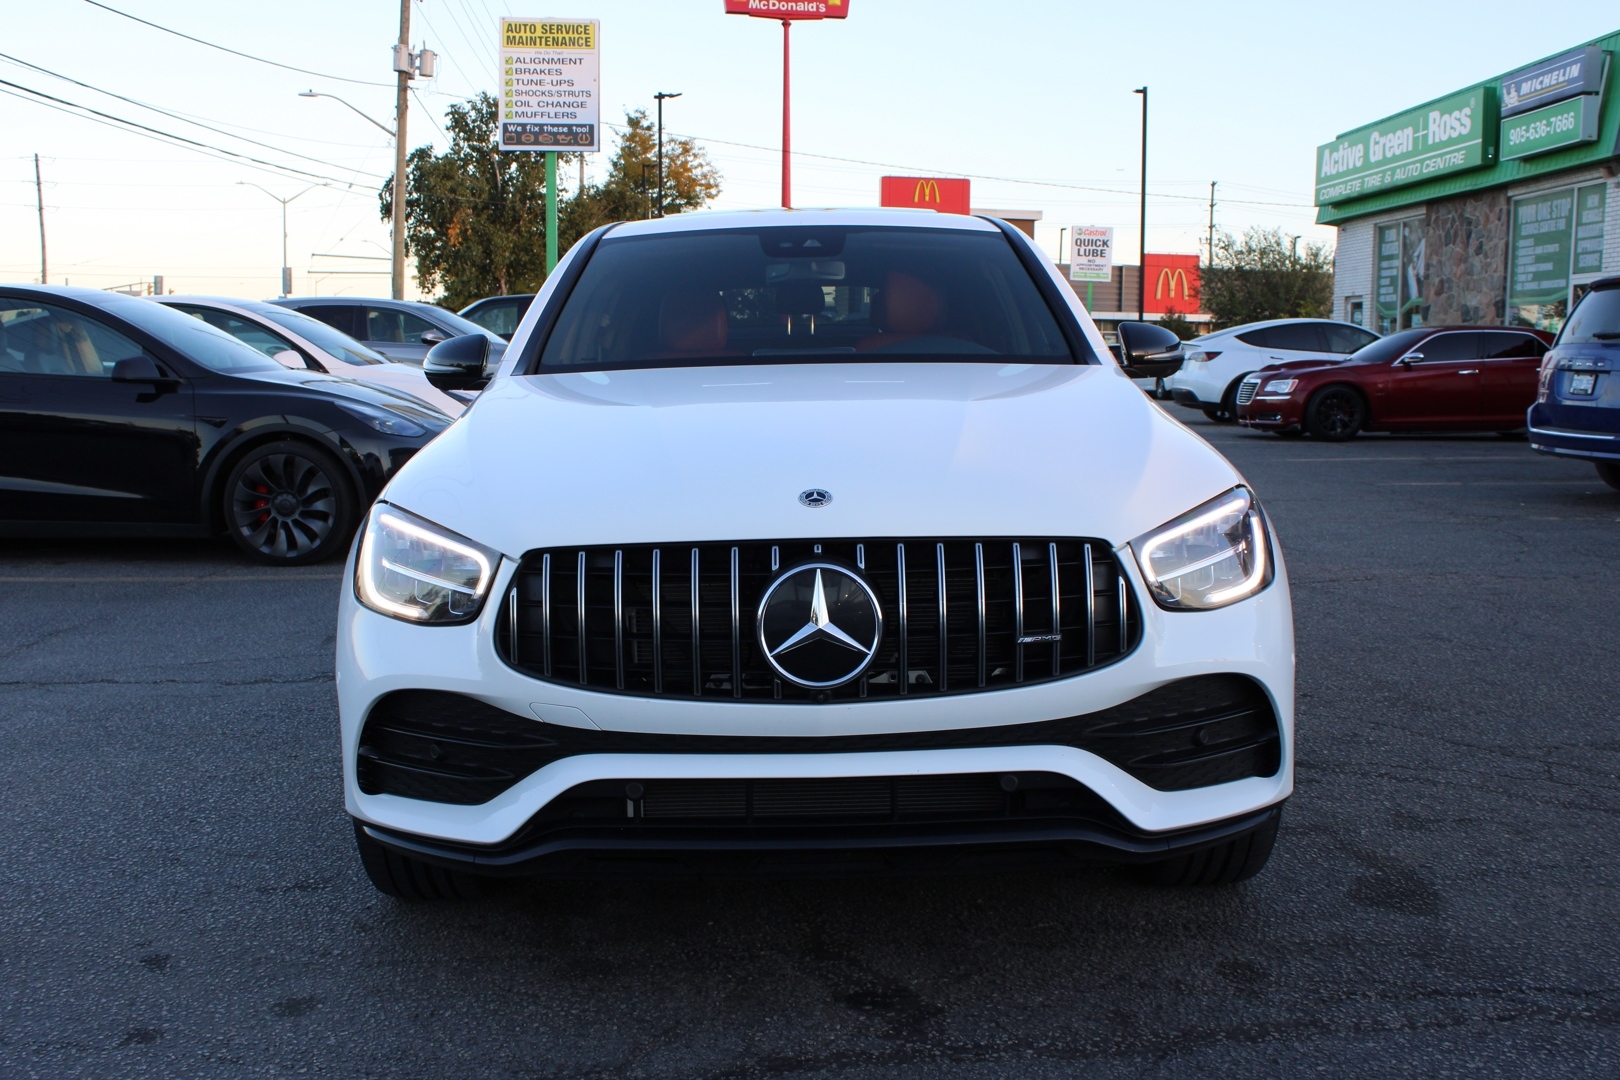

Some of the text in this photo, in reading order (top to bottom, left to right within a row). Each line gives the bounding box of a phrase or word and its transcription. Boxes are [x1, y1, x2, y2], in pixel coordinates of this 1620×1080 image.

[748, 0, 826, 12] McDonald's
[506, 23, 590, 35] AUTO SERVICE
[506, 35, 591, 47] MAINTENANCE
[515, 57, 584, 65] ALIGNMENT
[515, 68, 562, 76] BRAKES
[515, 79, 574, 87] TUNE-UPS
[1520, 63, 1580, 95] MICHELIN
[515, 89, 591, 98] SHOCKS/STRUTS
[515, 111, 577, 119] MUFFLERS
[507, 124, 522, 132] We
[526, 124, 539, 132] fix
[543, 125, 568, 133] these
[1509, 112, 1575, 146] 905-636-7666
[1321, 144, 1363, 177] Active
[1369, 126, 1413, 163] Green
[1428, 107, 1472, 144] Ross
[1319, 150, 1466, 200] COMPLETE TIRE & AUTO CENTRE
[1075, 237, 1110, 248] QUICK
[1077, 248, 1107, 258] LUBE
